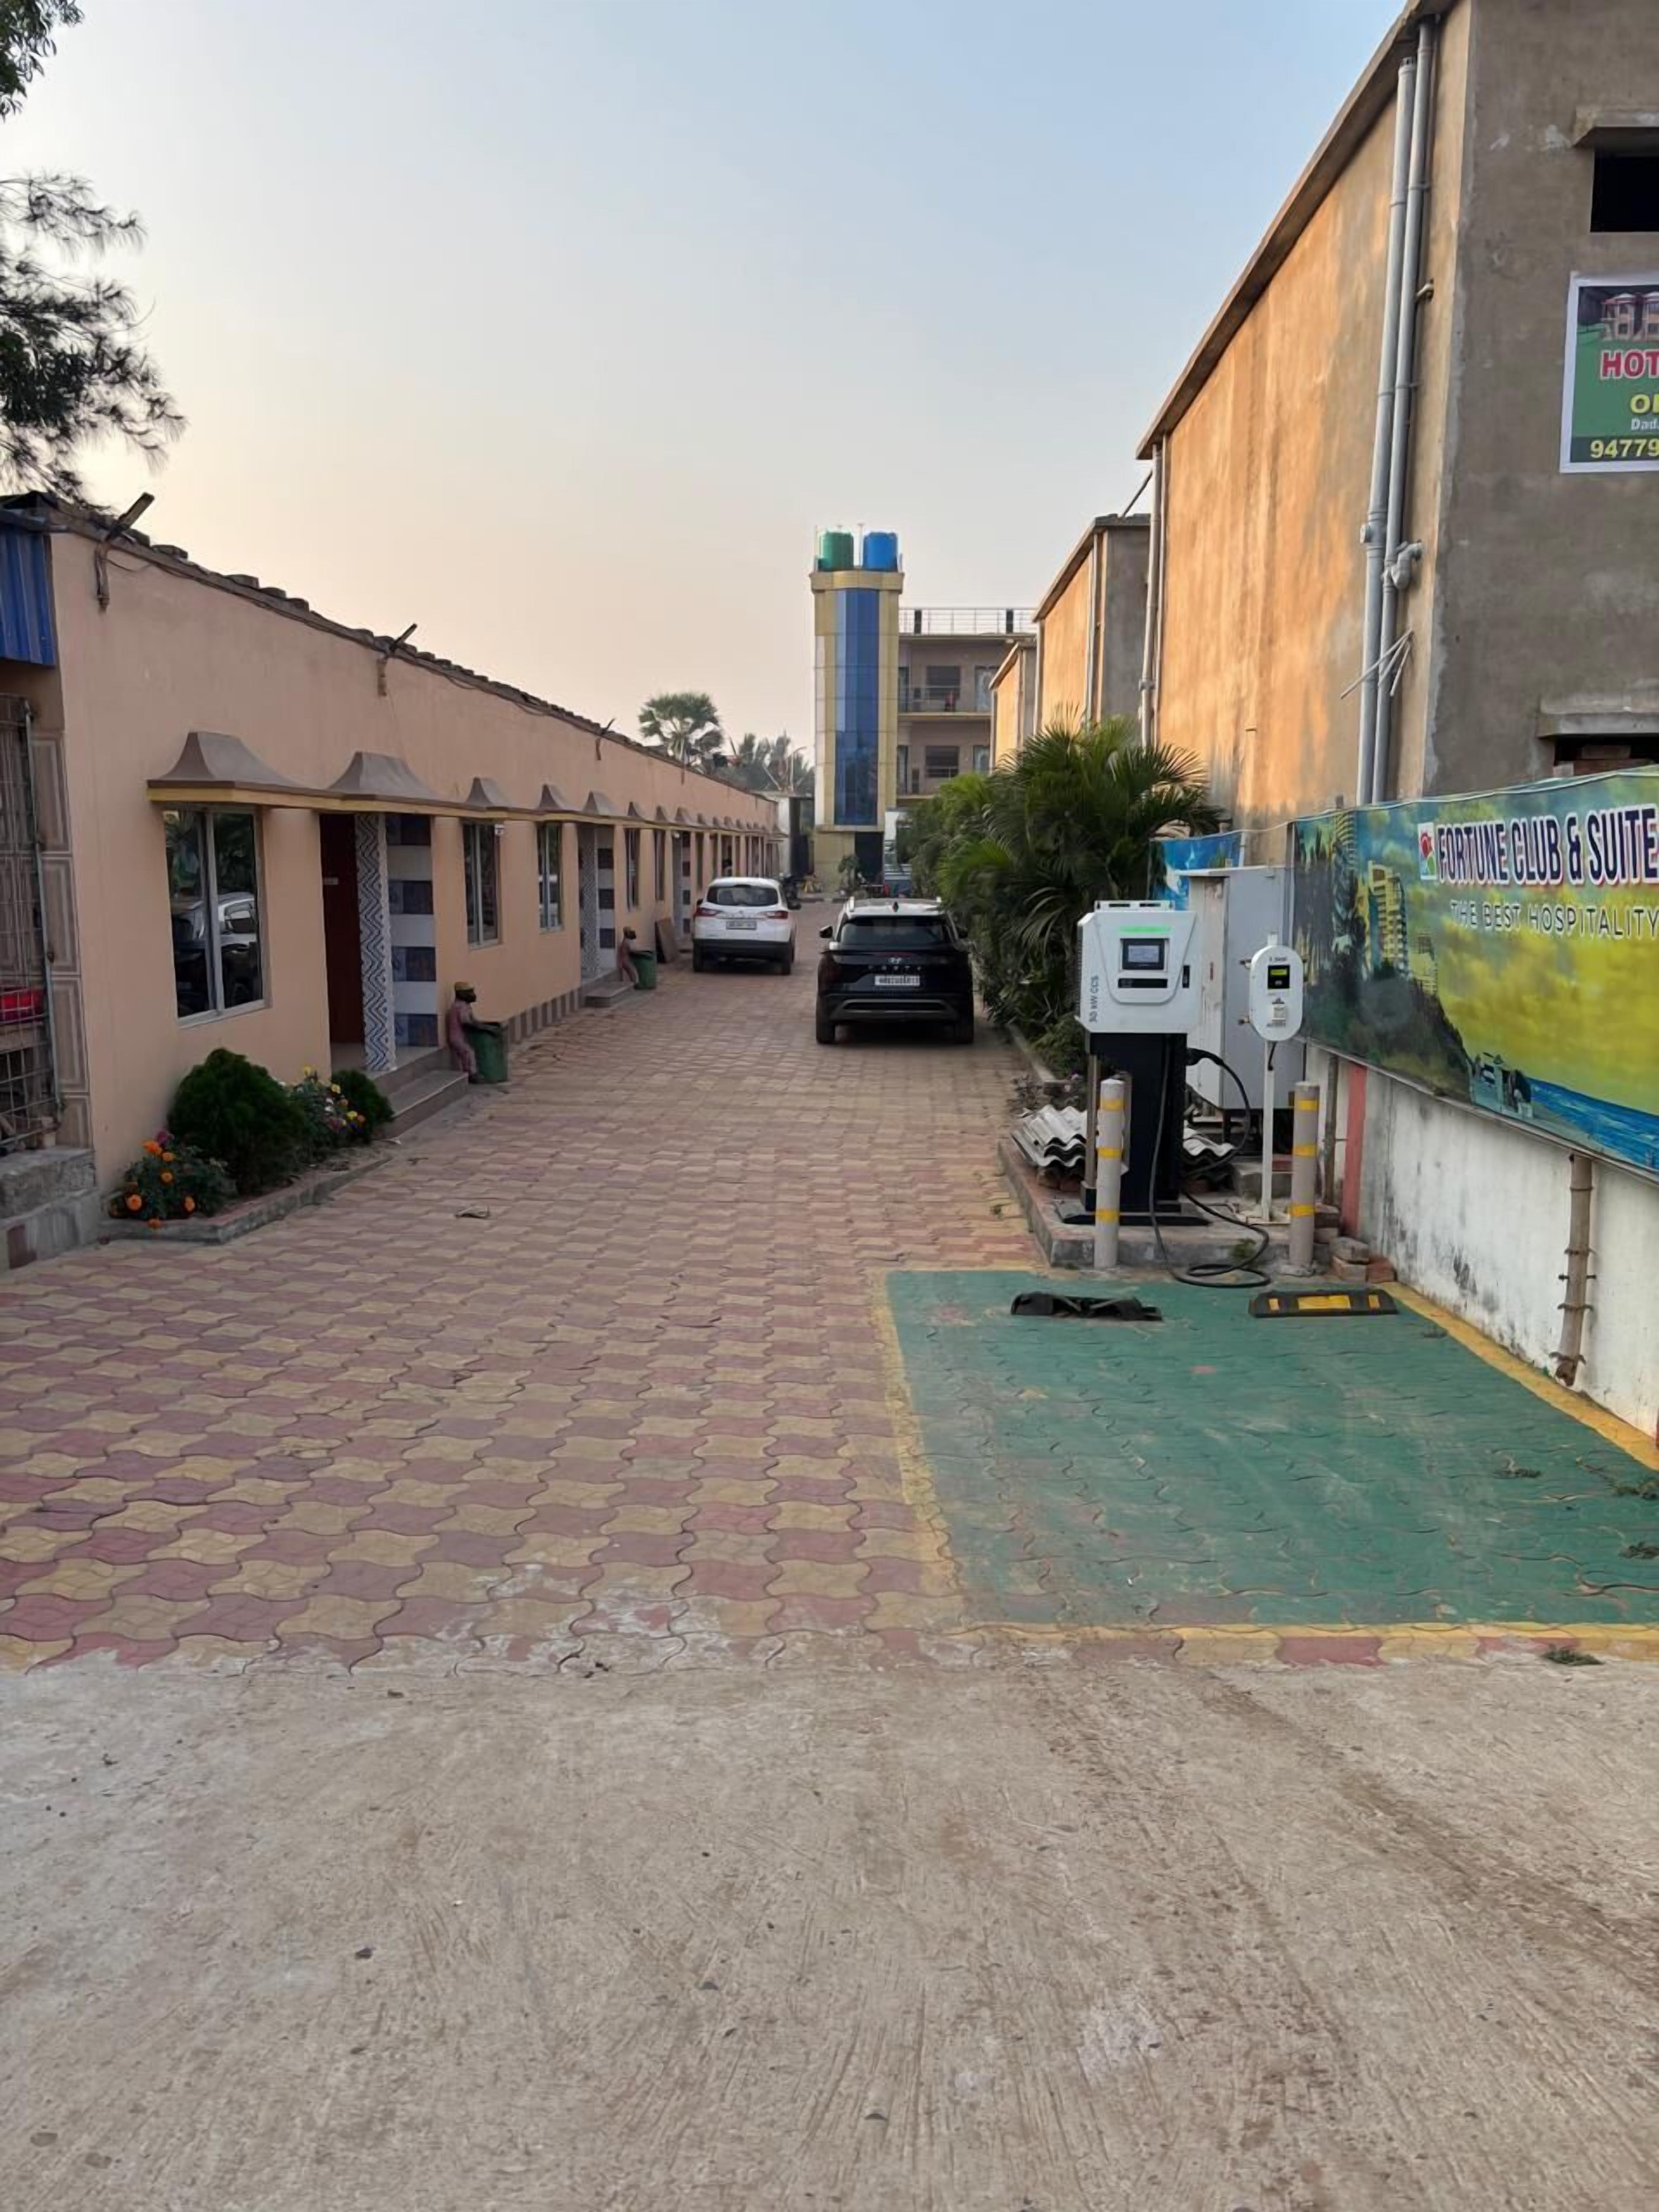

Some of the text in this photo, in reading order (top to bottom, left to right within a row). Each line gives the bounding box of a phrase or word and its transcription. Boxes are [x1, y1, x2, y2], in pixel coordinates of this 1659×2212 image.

[1436, 820, 1510, 884] FORTUNE
[1511, 816, 1563, 885] CLUB
[1565, 813, 1584, 885] &
[1451, 900, 1659, 939] THE BEST HOSPITALITY
